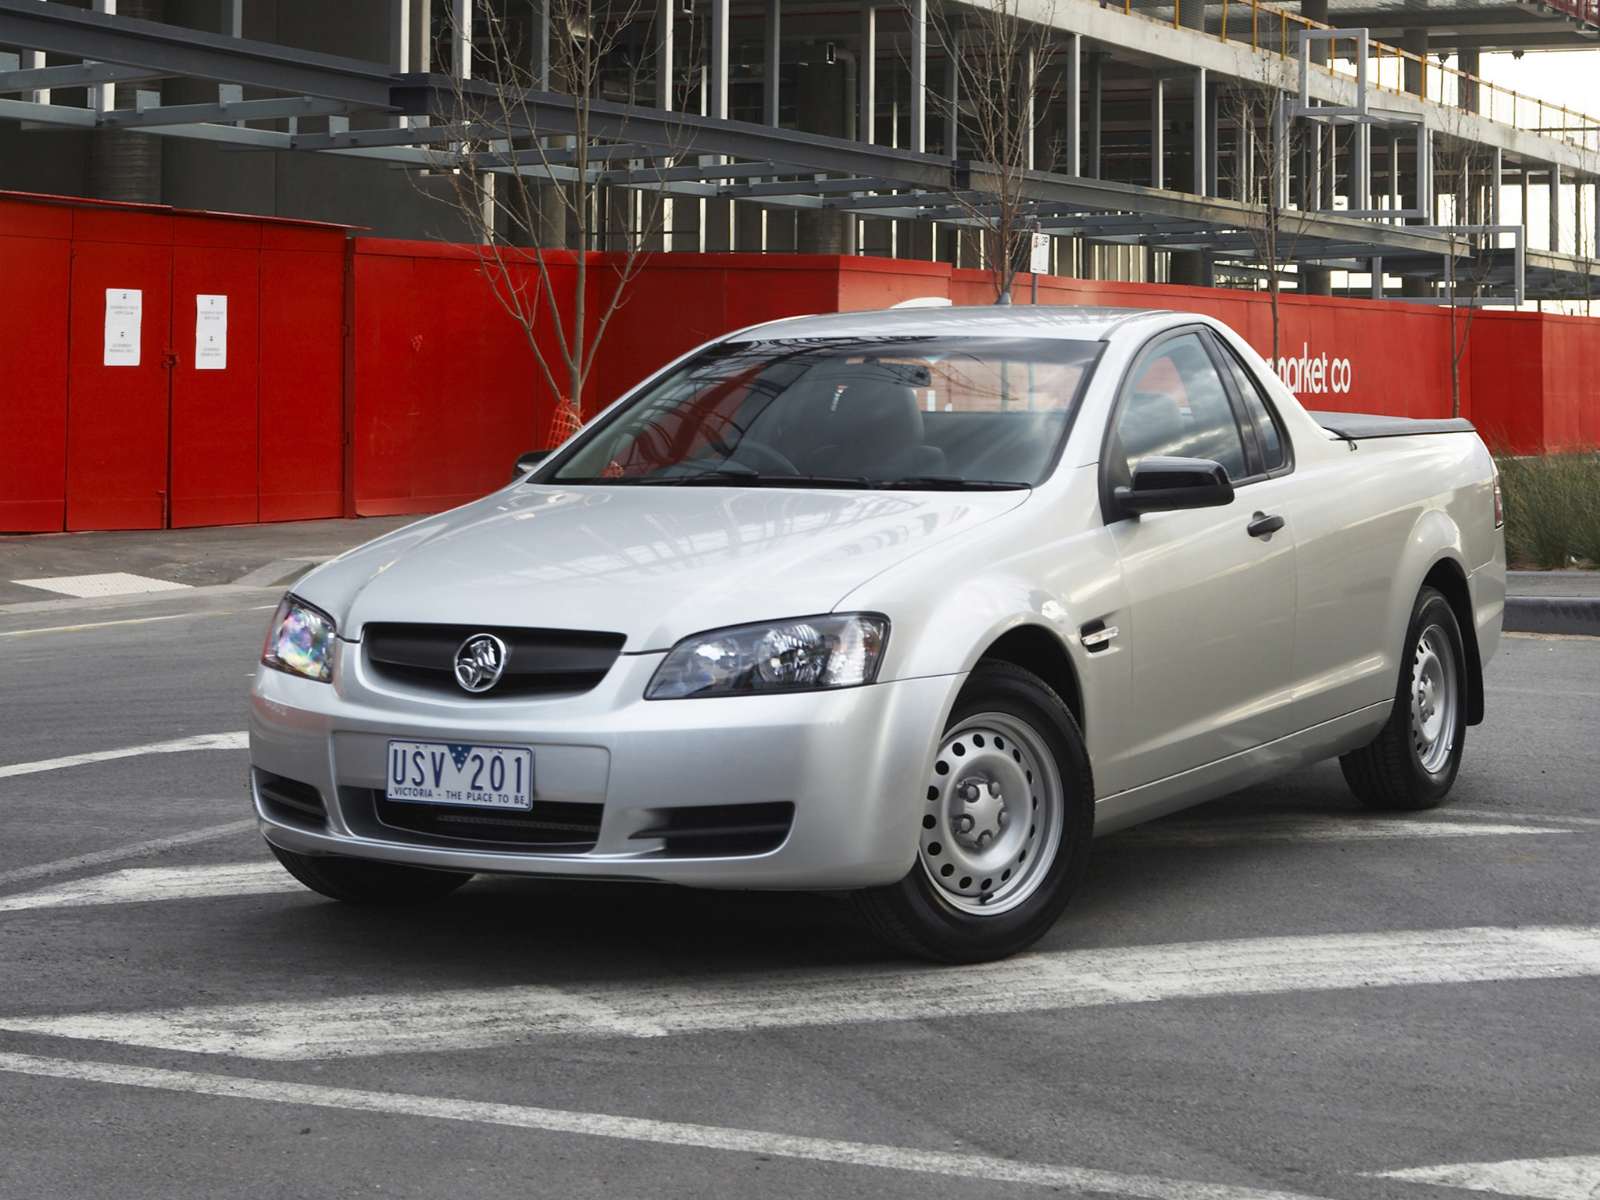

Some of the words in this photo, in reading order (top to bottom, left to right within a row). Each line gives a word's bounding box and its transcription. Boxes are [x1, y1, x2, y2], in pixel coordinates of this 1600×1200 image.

[1331, 357, 1352, 394] co
[393, 749, 445, 788] USV
[471, 754, 522, 794] 201
[394, 786, 433, 797] VICTORIA
[446, 790, 462, 800] THE
[467, 792, 493, 802] PLACE
[498, 794, 509, 803] TO
[514, 795, 525, 804] BE
